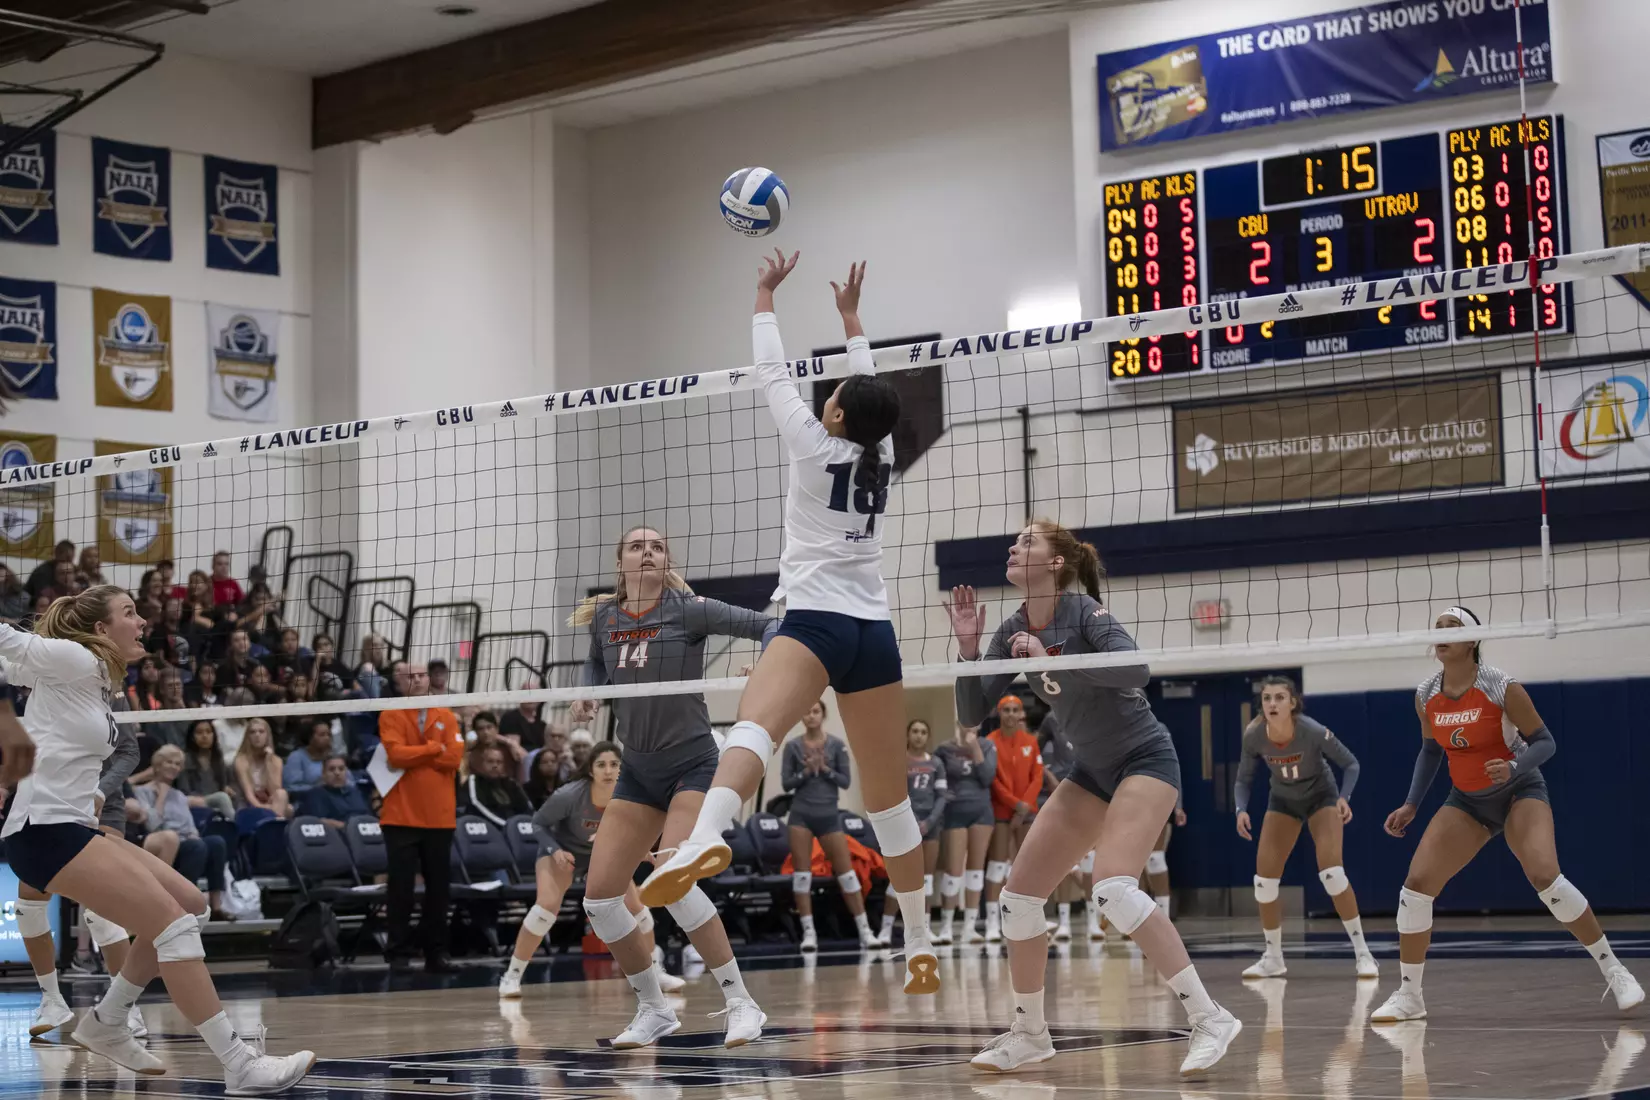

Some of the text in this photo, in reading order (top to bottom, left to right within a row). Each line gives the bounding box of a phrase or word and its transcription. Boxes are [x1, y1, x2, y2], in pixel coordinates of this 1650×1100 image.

[1217, 34, 1254, 58] THE
[1257, 25, 1311, 51] CARD
[1313, 15, 1363, 41] THAT
[1368, 3, 1439, 33] SHOWS
[1443, 0, 1485, 19] YOU
[1450, 119, 1550, 153] PLY AC KLS
[1305, 146, 1375, 195] 1:15
[1453, 145, 1549, 182] 03 1 0
[109, 171, 155, 195] NAIA
[1105, 173, 1195, 206] PLY AC KLS
[1454, 176, 1550, 213] 06 0 0
[220, 188, 264, 211] NAIA
[1365, 192, 1419, 219] UTRGV
[1107, 208, 1136, 233] 04
[1143, 204, 1158, 228] 0
[1238, 214, 1268, 238] CBU
[1300, 215, 1343, 234] PERIOD
[1456, 215, 1487, 243] 08
[1505, 214, 1512, 234] 1
[1108, 235, 1137, 262] 07
[1144, 232, 1158, 256] 0
[1316, 237, 1333, 272] 3
[1413, 218, 1435, 263] 2
[1116, 255, 1196, 288] 10 0 3
[1250, 241, 1271, 285] 2
[1468, 299, 1557, 331] 14 1 3
[1305, 337, 1348, 356] MATCH
[1405, 325, 1445, 343] SCORE
[149, 447, 181, 465] CBU
[240, 420, 369, 453] #LANCEUP
[437, 406, 473, 427] CBU
[544, 374, 699, 412] #LANCEUP
[909, 320, 1093, 363] #LANCEUP
[1189, 300, 1240, 325] CBU
[1278, 304, 1304, 314] adidas
[1341, 257, 1558, 306] #LANCEUP
[1112, 344, 1199, 377] 20 0 1
[1213, 349, 1250, 367] SCORE
[1223, 418, 1486, 461] RIVERSIDE MEDICAL CLINIC
[1389, 442, 1487, 463] Legendary Care
[608, 624, 664, 644] UTRGV
[617, 641, 649, 668] 14
[1434, 708, 1482, 727] UTRGV
[1450, 727, 1469, 748] 6
[913, 774, 930, 789] 13
[962, 761, 972, 775] 5
[1281, 765, 1299, 779] 11
